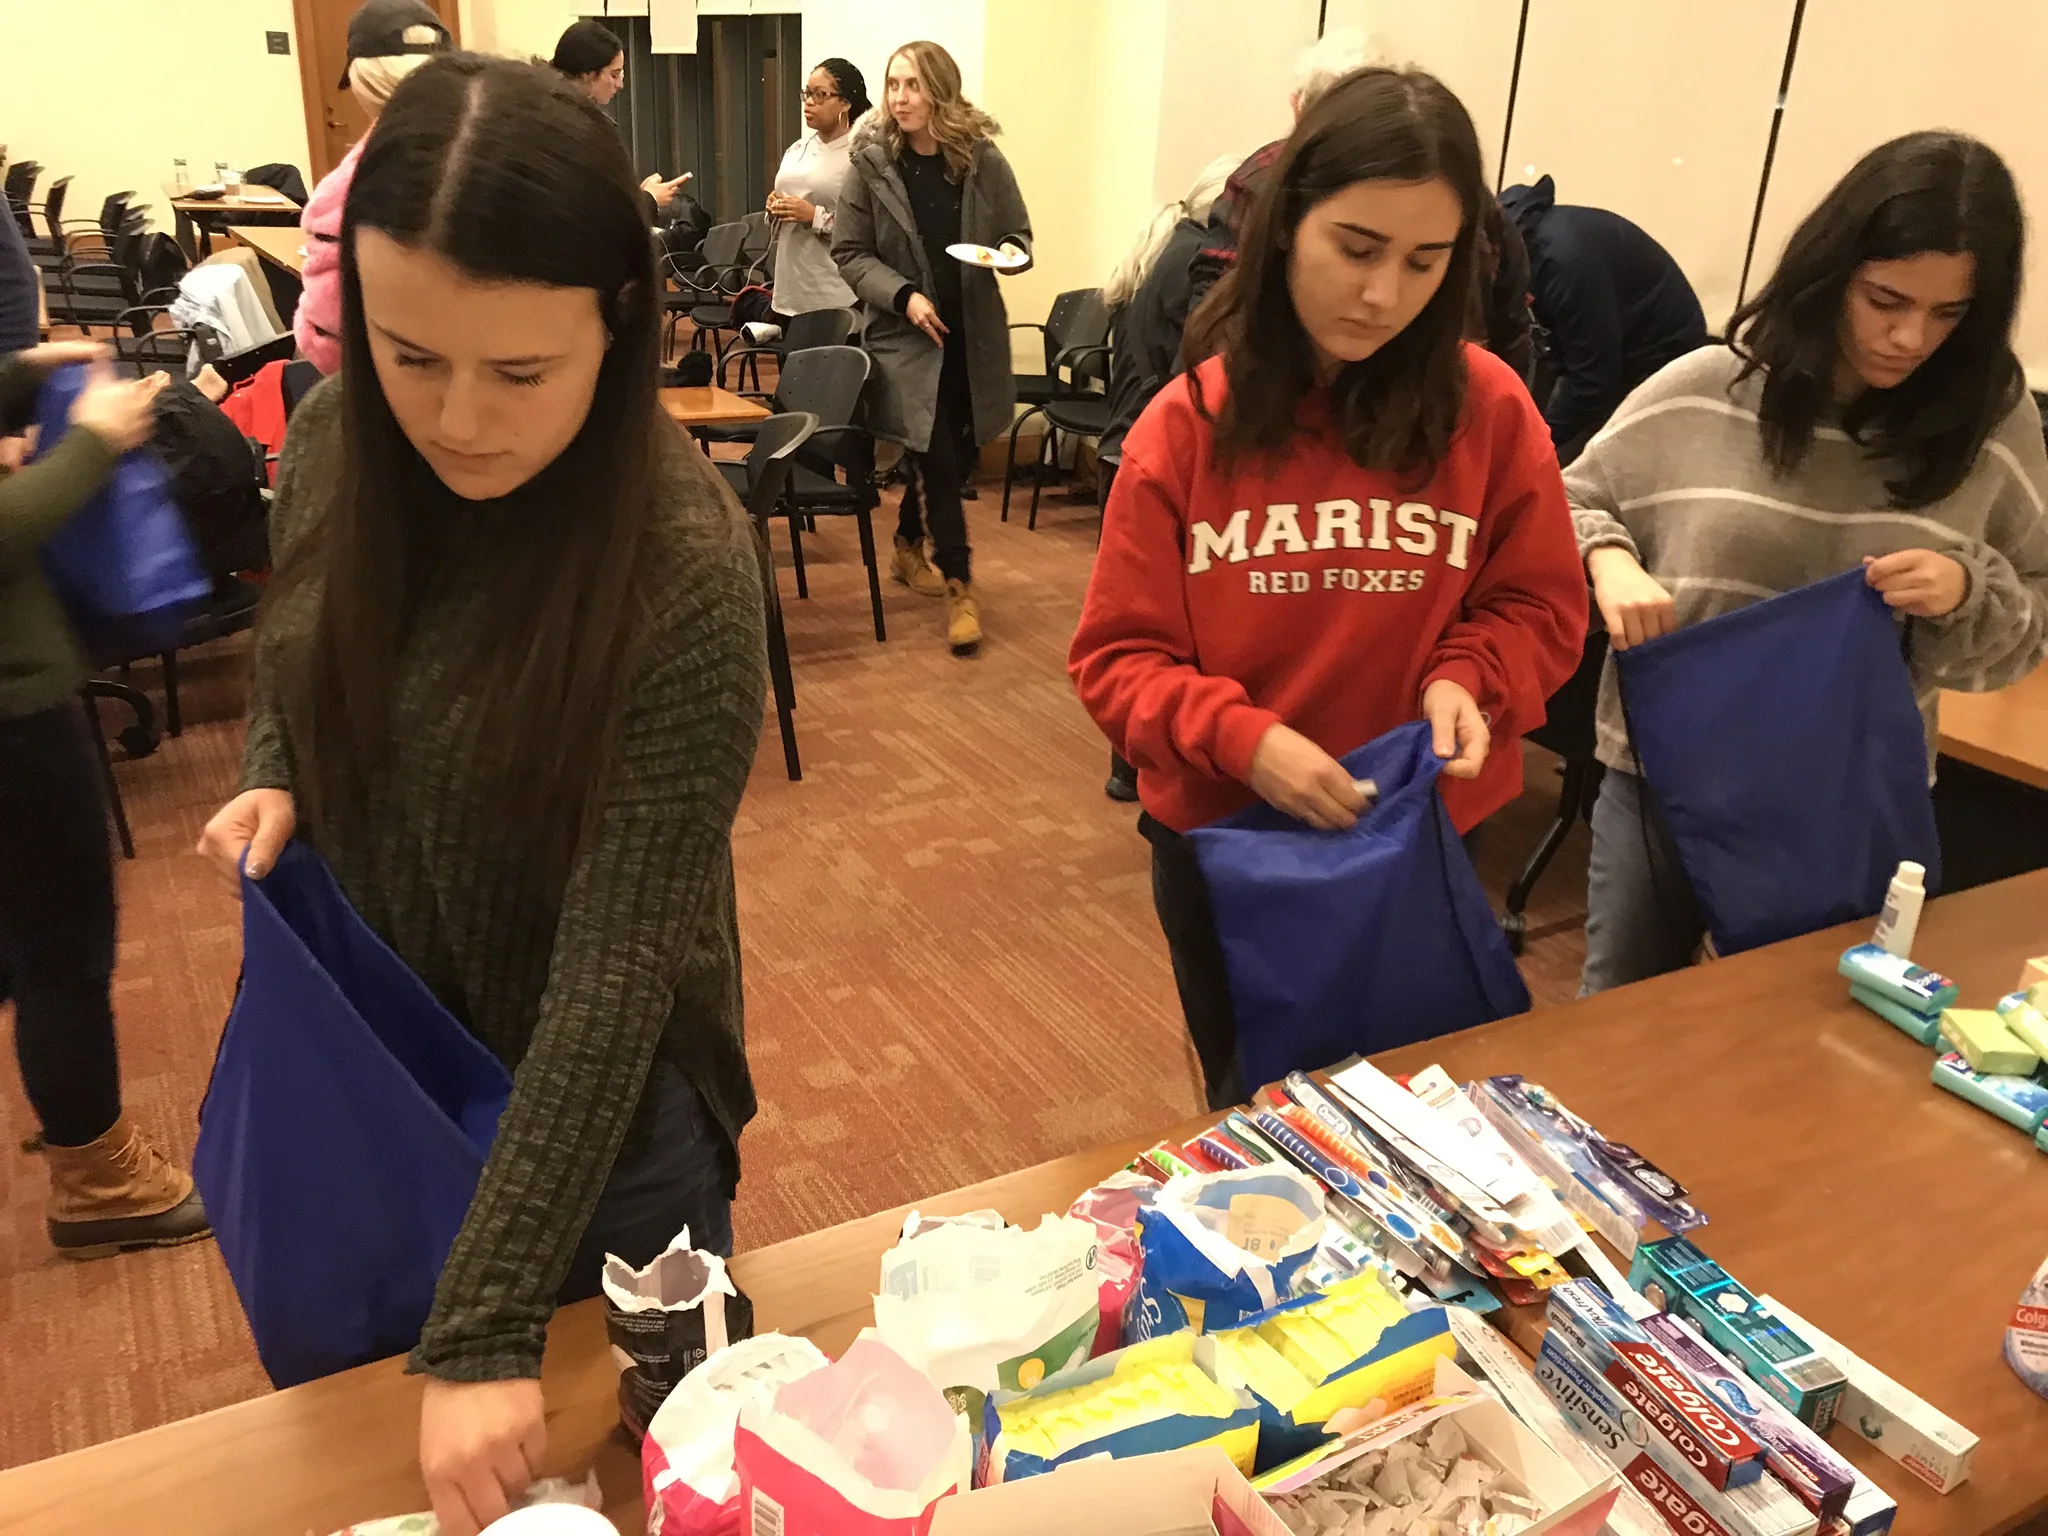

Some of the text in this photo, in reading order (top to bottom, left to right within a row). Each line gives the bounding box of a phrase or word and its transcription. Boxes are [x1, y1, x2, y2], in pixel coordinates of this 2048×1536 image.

[1188, 498, 1478, 575] MARIST
[1248, 568, 1426, 594] RED FOXES
[2015, 1309, 2048, 1329] Colg
[1545, 1347, 1587, 1388] Protection
[1541, 1366, 1624, 1450] Sensitive
[1582, 1381, 1619, 1419] Complete
[1625, 1380, 1709, 1468] Colgate
[1637, 1349, 1741, 1447] Colgate
[1784, 1452, 1820, 1482] Colgate
[1639, 1468, 1716, 1536] gate
